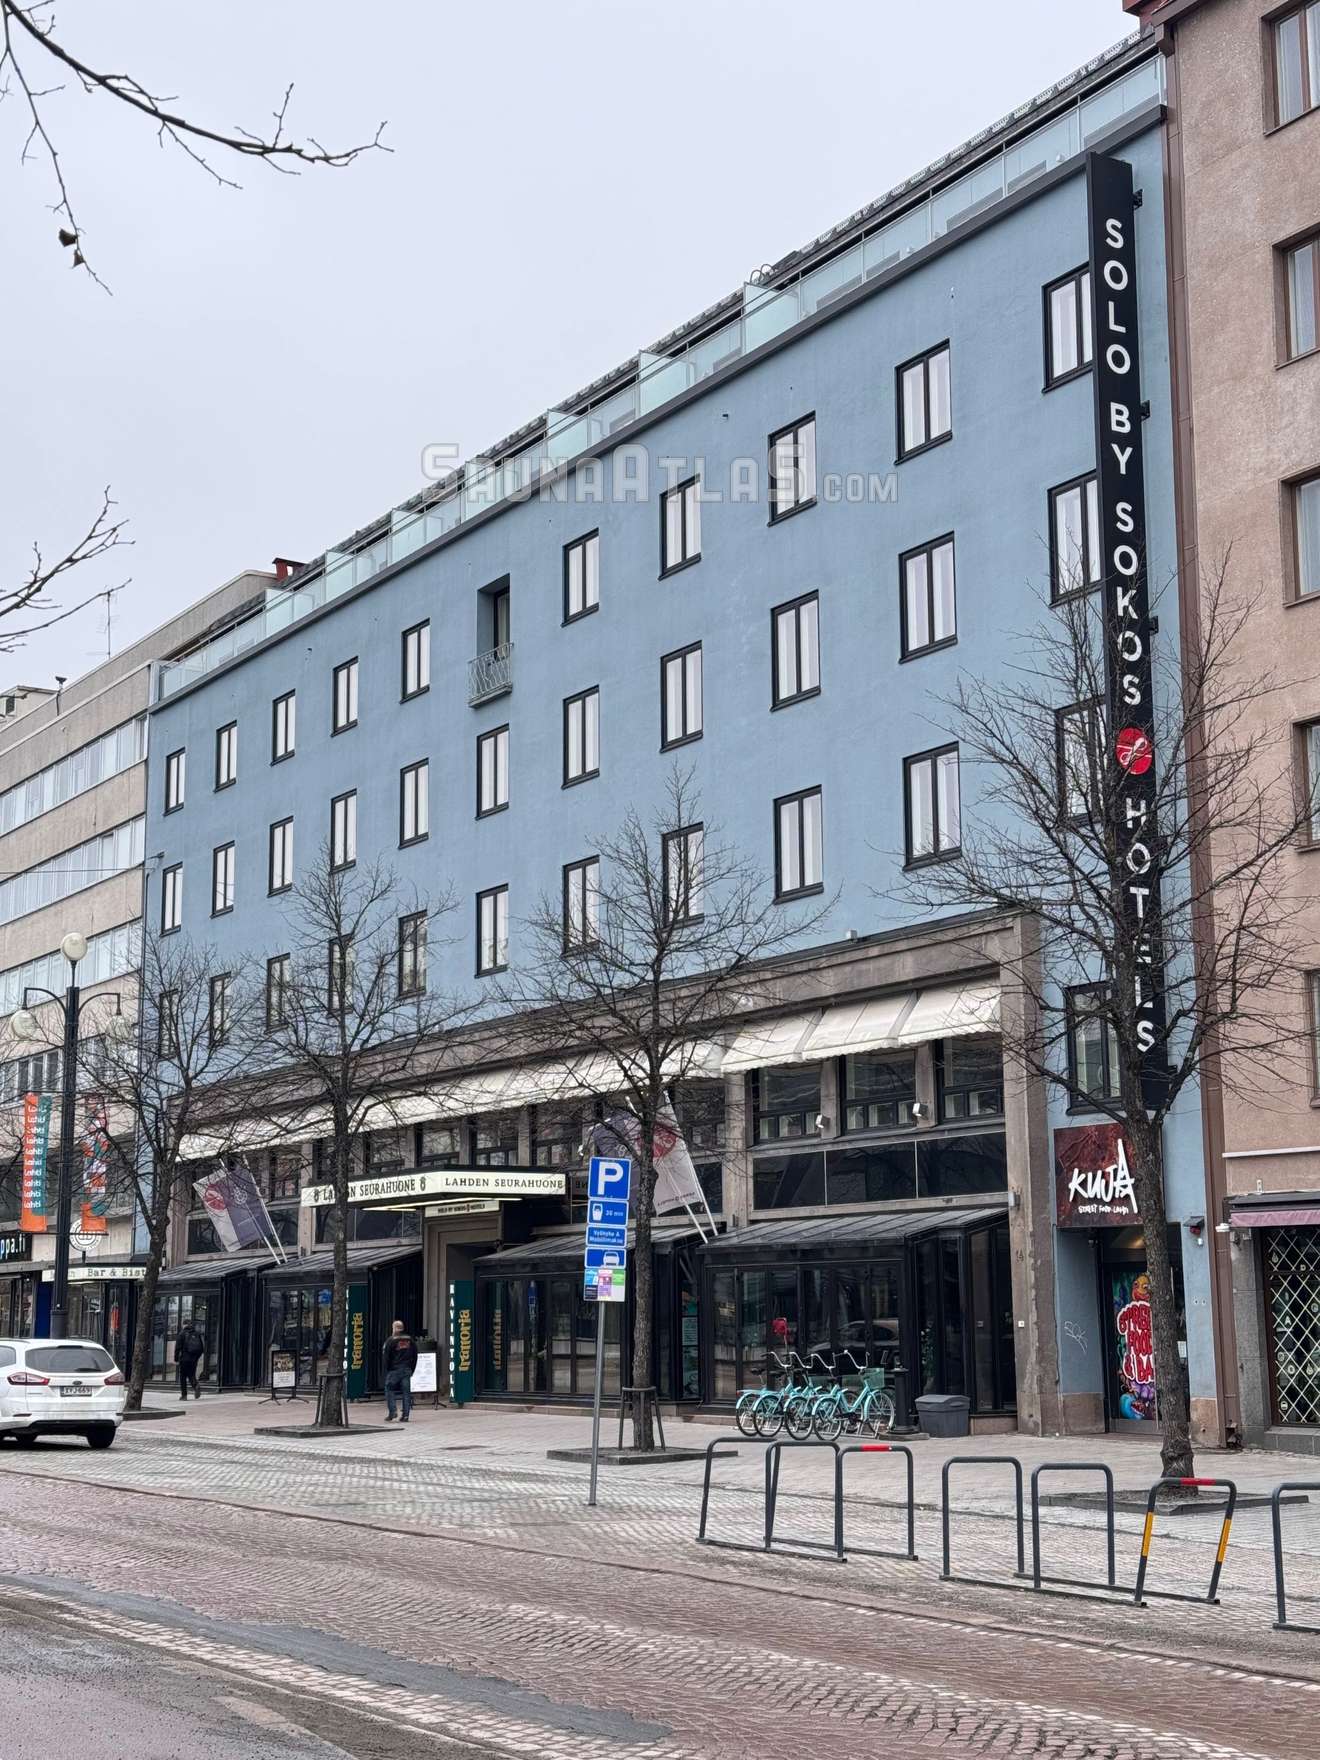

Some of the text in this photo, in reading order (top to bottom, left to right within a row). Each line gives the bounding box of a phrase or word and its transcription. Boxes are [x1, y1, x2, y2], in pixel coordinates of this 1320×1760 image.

[1103, 218, 1154, 1052] SOLO BY SOKOS HOTELS
[445, 1177, 563, 1189] LAHDEN SEURAHUONE
[598, 1161, 624, 1195] P
[1068, 1138, 1138, 1214] KUJA
[323, 1179, 415, 1202] LAN SEURAHUONE
[87, 1268, 104, 1277] Bar
[109, 1268, 116, 1277] &
